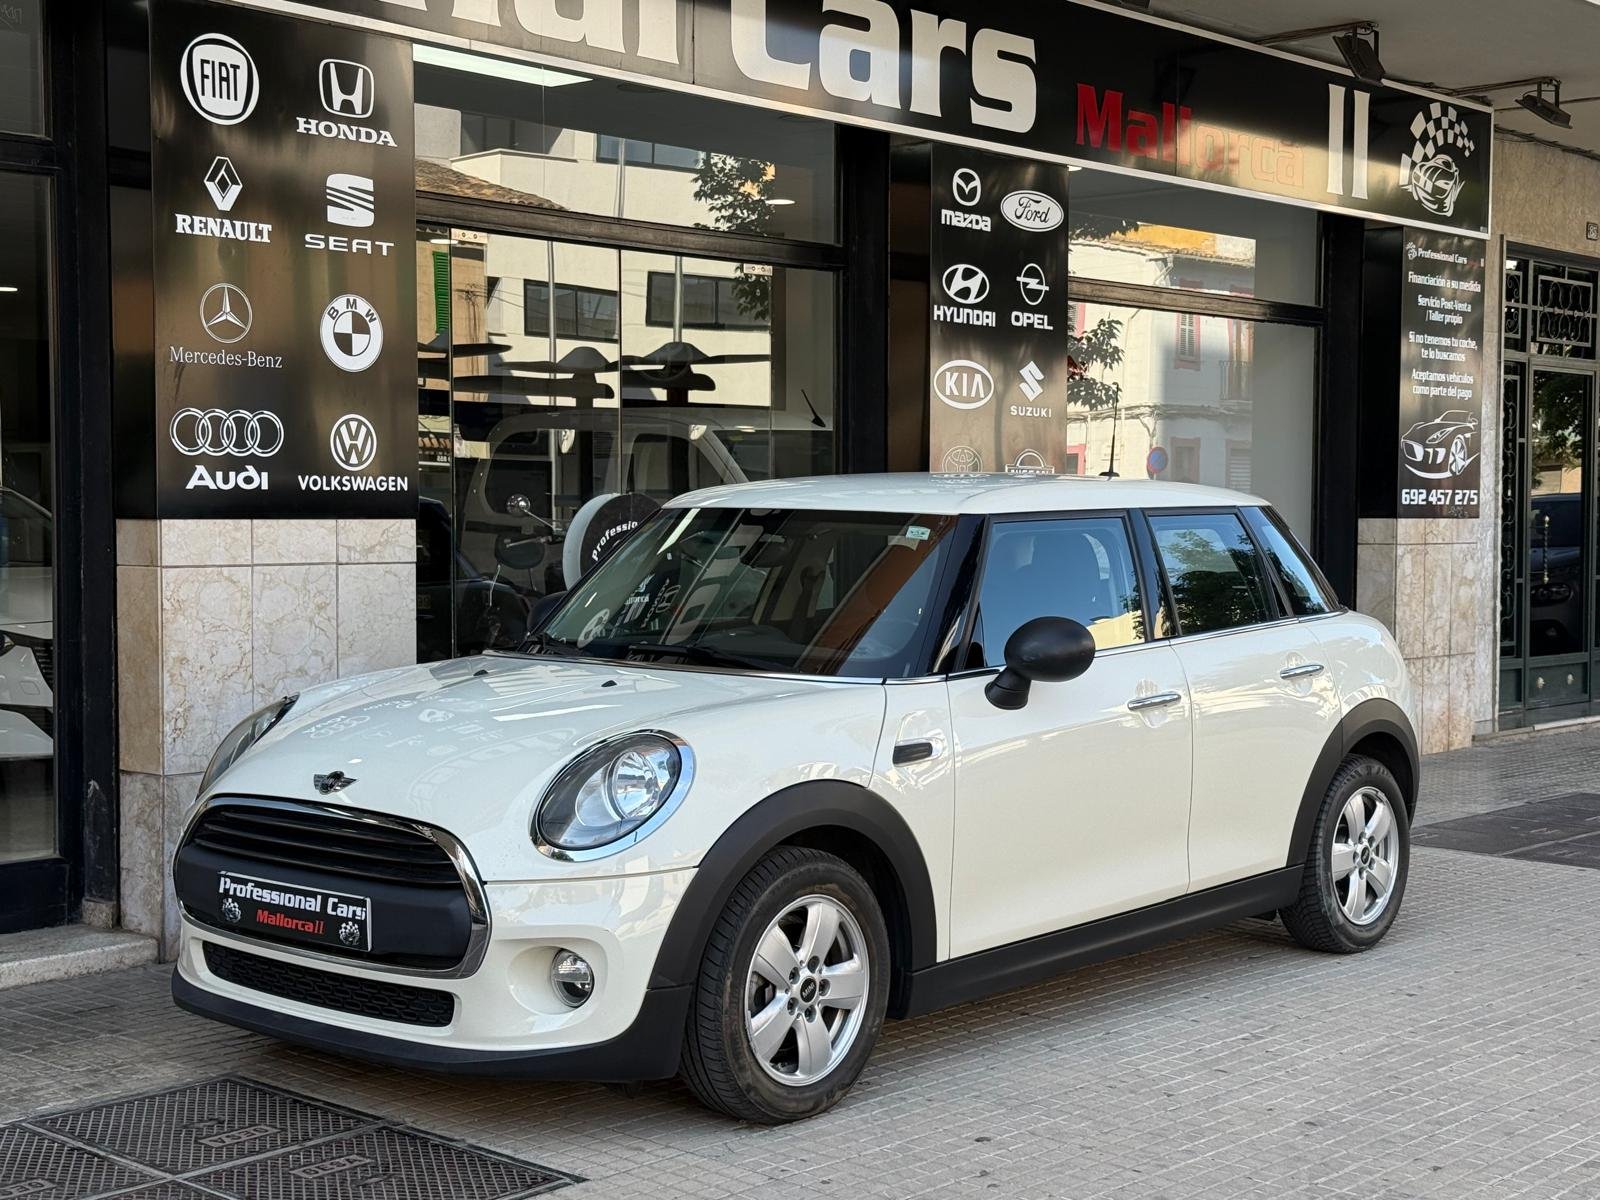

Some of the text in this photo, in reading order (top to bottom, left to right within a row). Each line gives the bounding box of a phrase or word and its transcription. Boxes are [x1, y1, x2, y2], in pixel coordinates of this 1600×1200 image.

[731, 0, 1037, 133] Cars
[200, 58, 241, 102] FIAT
[296, 117, 398, 148] HONDA
[1076, 82, 1304, 189] Mallorca
[1014, 196, 1051, 224] Ford
[175, 213, 272, 243] RENAULT
[304, 233, 395, 256] SEAT
[1418, 248, 1454, 263] Professional
[1455, 254, 1468, 265] Cars
[1446, 279, 1451, 288] a
[1451, 280, 1459, 289] su
[1459, 281, 1481, 293] medida
[327, 297, 377, 324] BMW
[1417, 294, 1441, 308] Servicio
[933, 304, 996, 328] HYUNDAI
[1011, 310, 1053, 331] OPEL
[1409, 331, 1415, 343] Si
[1416, 334, 1423, 344] no
[1424, 334, 1451, 347] tenemos
[169, 346, 283, 369] Mercedes-Benz
[1421, 348, 1466, 361] te lo buscamos
[945, 371, 985, 399] KIA
[1412, 368, 1447, 383] Aceptamos
[1412, 385, 1473, 400] como parte del pago
[1010, 405, 1052, 418] SUZUKI
[185, 465, 269, 490] Audi
[298, 475, 409, 492] VOLKSWAGEN
[1401, 488, 1478, 505] 692 457 275
[219, 876, 367, 921] Professional Cars
[256, 909, 314, 933] Mallorca
